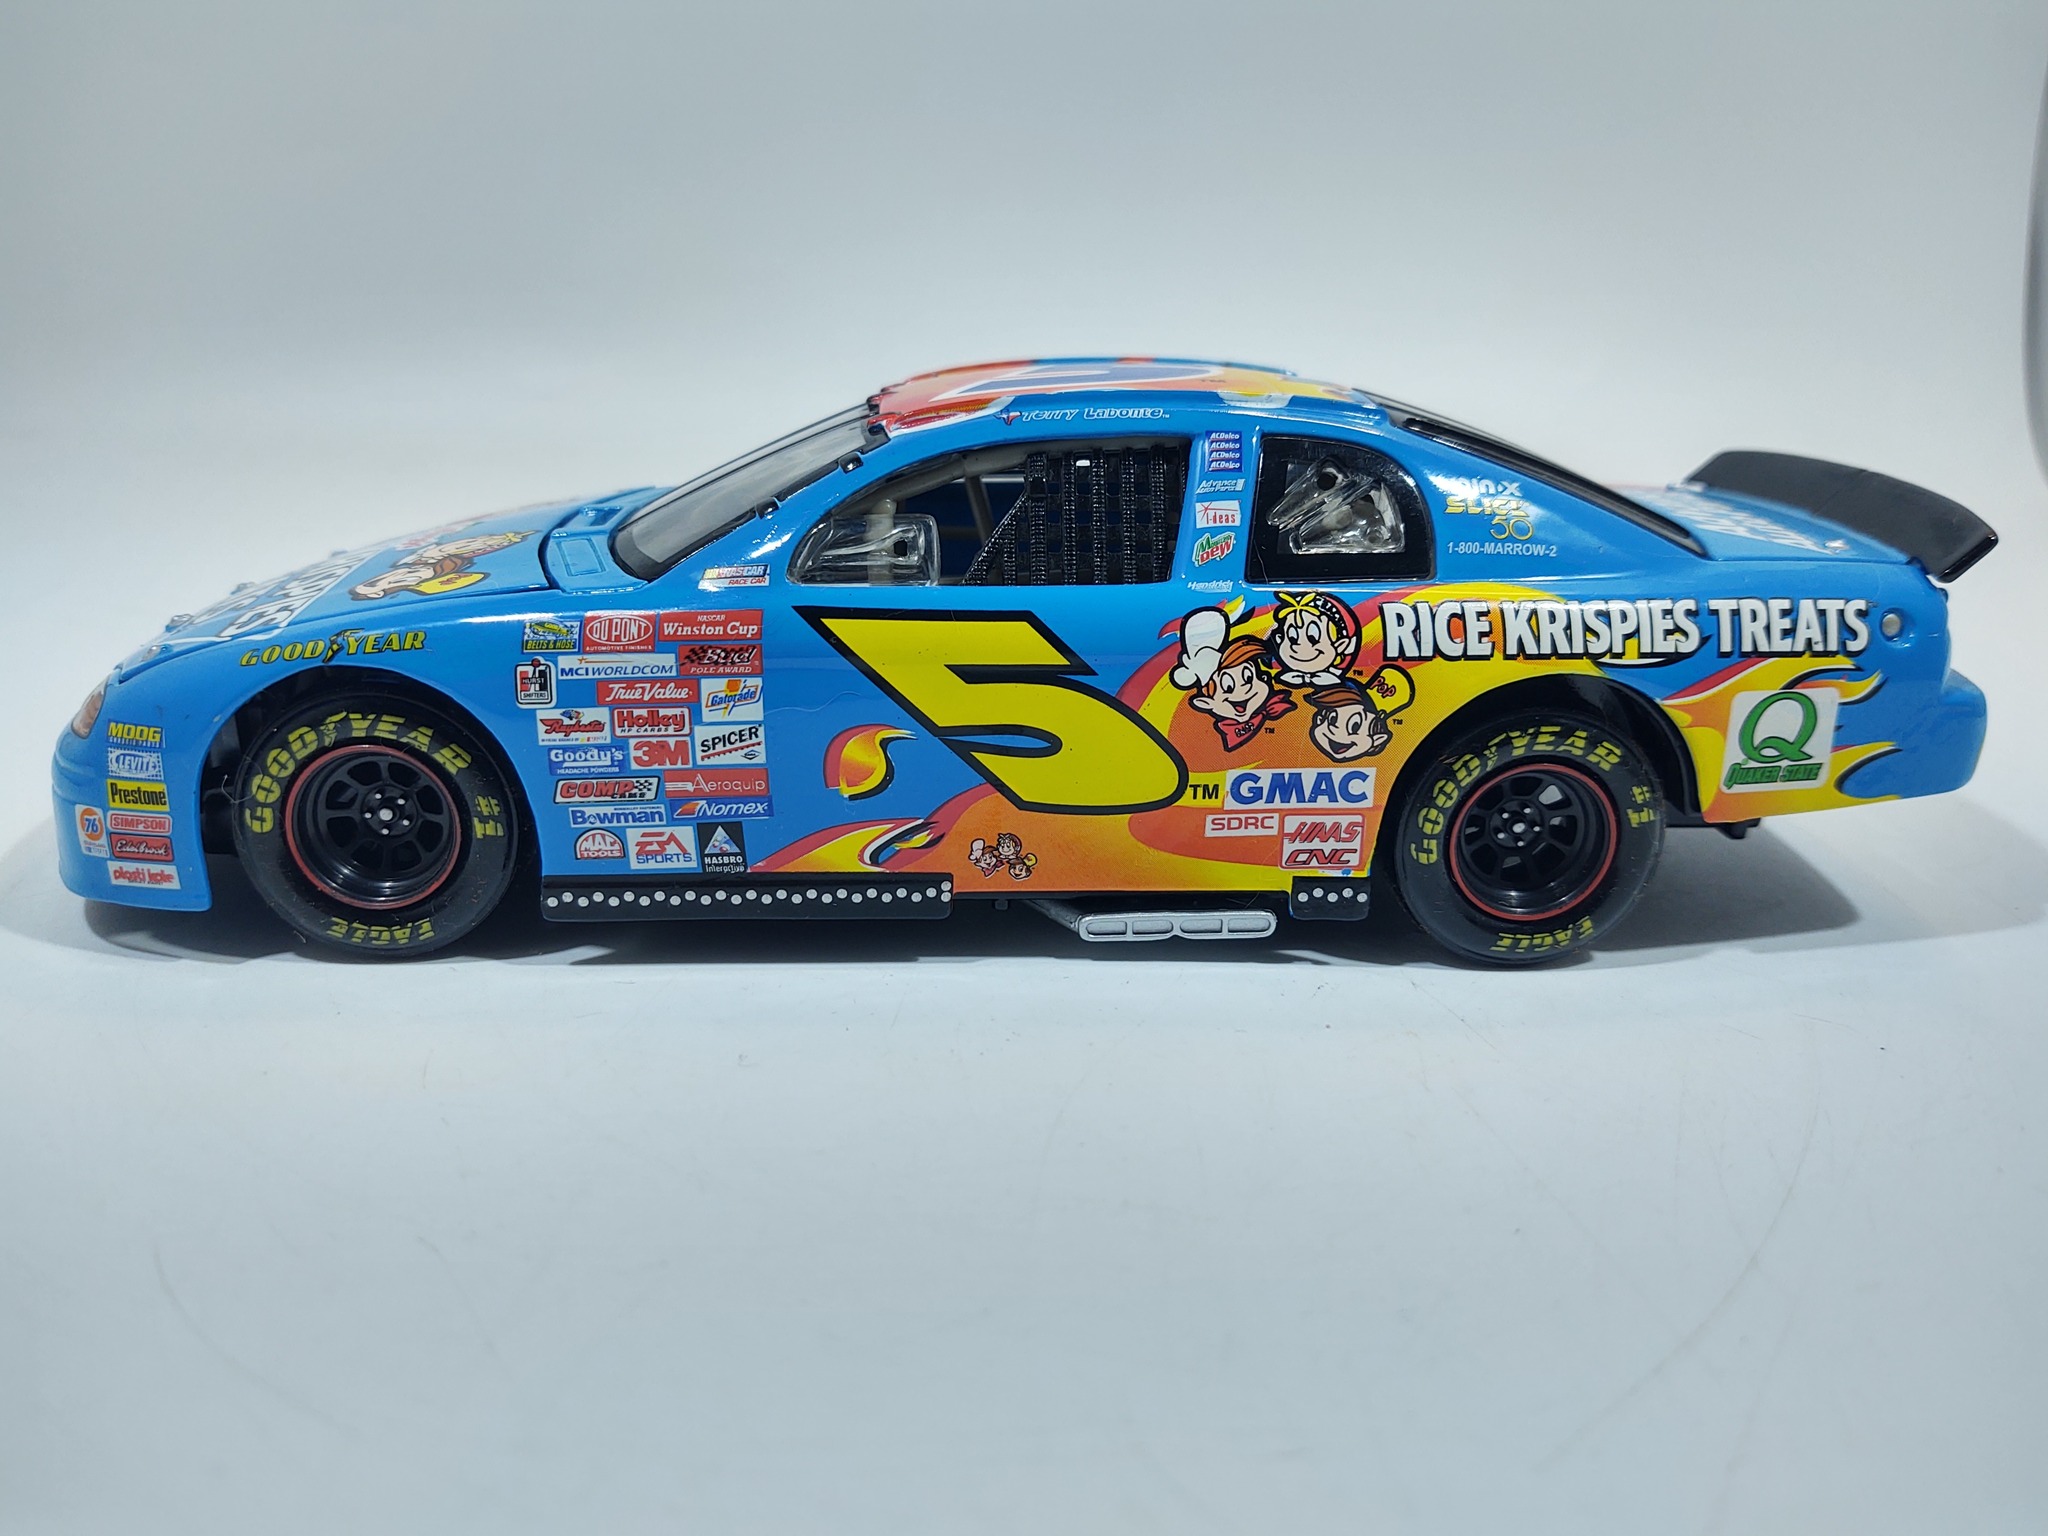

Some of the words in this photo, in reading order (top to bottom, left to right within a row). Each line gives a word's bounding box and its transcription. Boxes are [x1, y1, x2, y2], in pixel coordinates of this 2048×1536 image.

[1022, 409, 1079, 421] Terry
[1210, 432, 1240, 440] ACDelco
[1210, 461, 1240, 469] ACDelco
[1490, 516, 1534, 540] 50
[1447, 542, 1557, 557] 1-800-MARROW-2
[697, 614, 725, 622] NASCAR
[663, 622, 724, 636] Winston
[727, 621, 758, 638] Cup
[1381, 600, 1493, 660] RICE
[1501, 599, 1700, 660] KRISPIES
[1708, 598, 1870, 657] TREATS
[527, 640, 548, 650] BELTS
[556, 639, 574, 649] HOSE
[717, 666, 752, 674] AWARD
[711, 689, 755, 706] Gatorade
[791, 605, 1189, 816] 5
[616, 710, 686, 732] Holley
[1738, 691, 1817, 764] Q
[108, 722, 162, 742] MOOG
[701, 726, 760, 753] SPICER
[550, 746, 624, 767] Goody's
[633, 740, 690, 767] 3M
[560, 780, 635, 798] COMP
[693, 773, 766, 792] Aeroquip
[1230, 771, 1370, 804] GMAC
[110, 782, 167, 806] Prestone
[1189, 784, 1219, 800] TM
[571, 809, 665, 826] Bowman
[699, 801, 767, 817] Nomex
[84, 817, 99, 834] 76
[113, 816, 167, 830] SIMPSON
[1210, 815, 1275, 831] SDRC
[1287, 821, 1362, 843] HAAS
[581, 850, 621, 858] TOOLS
[636, 853, 692, 864] SPORTS
[704, 856, 743, 864] HASBRO
[1286, 849, 1358, 866] CNC
